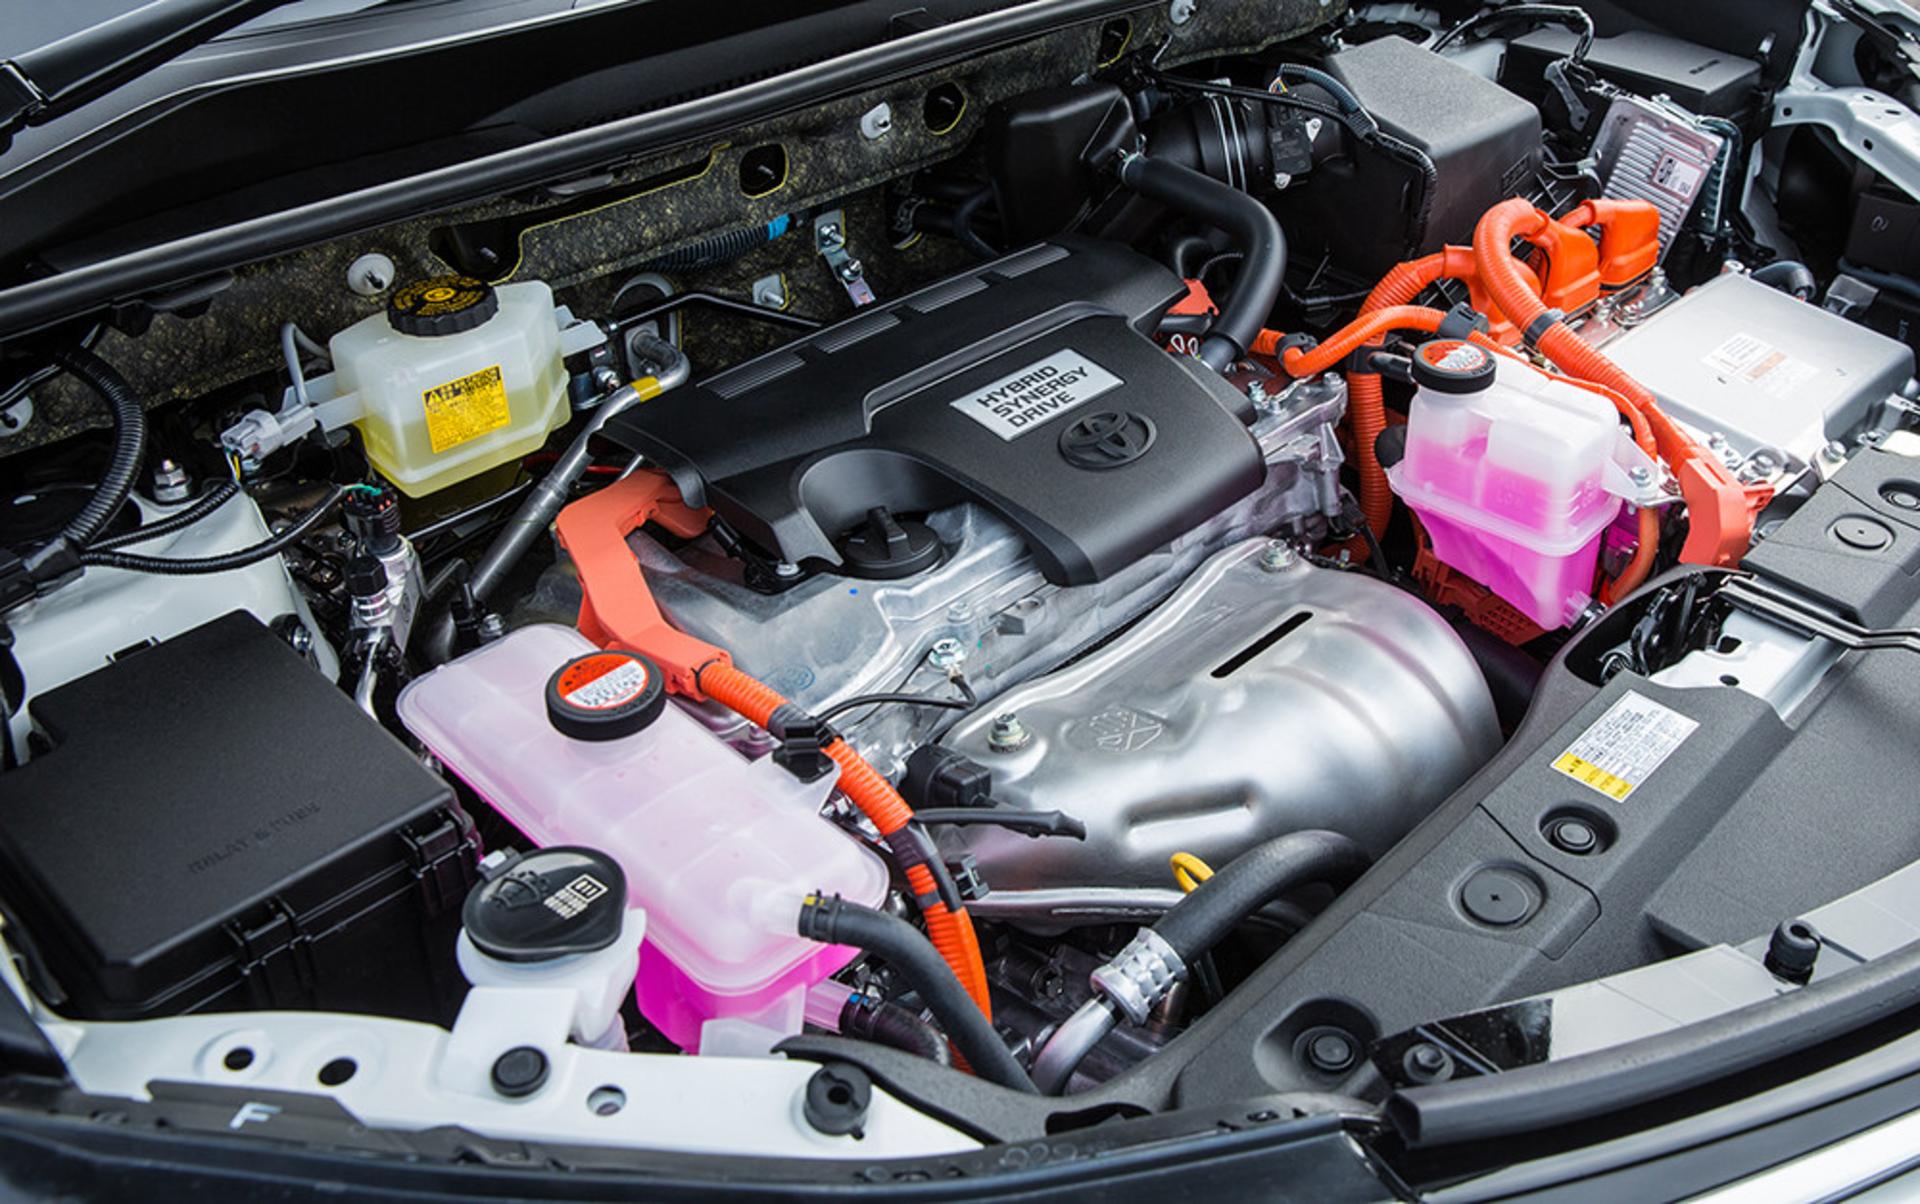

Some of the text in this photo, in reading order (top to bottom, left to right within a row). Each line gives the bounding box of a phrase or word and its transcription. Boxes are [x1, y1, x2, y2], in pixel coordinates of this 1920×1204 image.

[976, 365, 1058, 408] HYBRID
[992, 366, 1088, 418] SYNERGY
[1007, 390, 1075, 428] DRIVE
